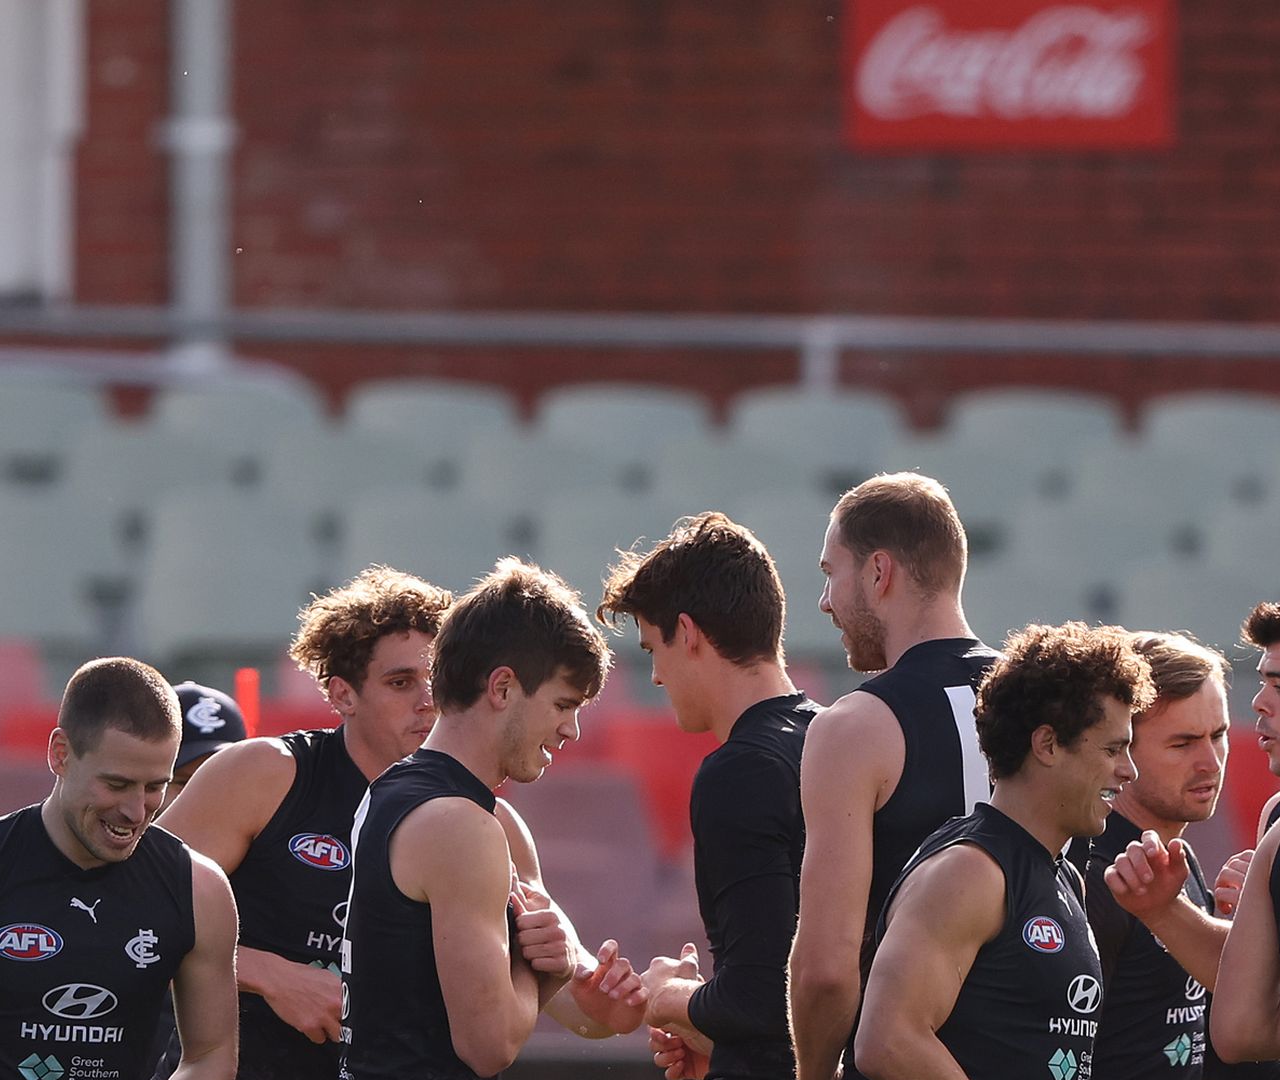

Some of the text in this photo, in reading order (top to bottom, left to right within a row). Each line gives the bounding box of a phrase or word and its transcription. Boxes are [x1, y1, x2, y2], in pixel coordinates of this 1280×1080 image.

[293, 838, 345, 866] AFL
[1029, 925, 1063, 944] AFL
[21, 1022, 124, 1043] HYUNDAI
[71, 1056, 105, 1067] Great
[69, 1067, 119, 1079] Southern
